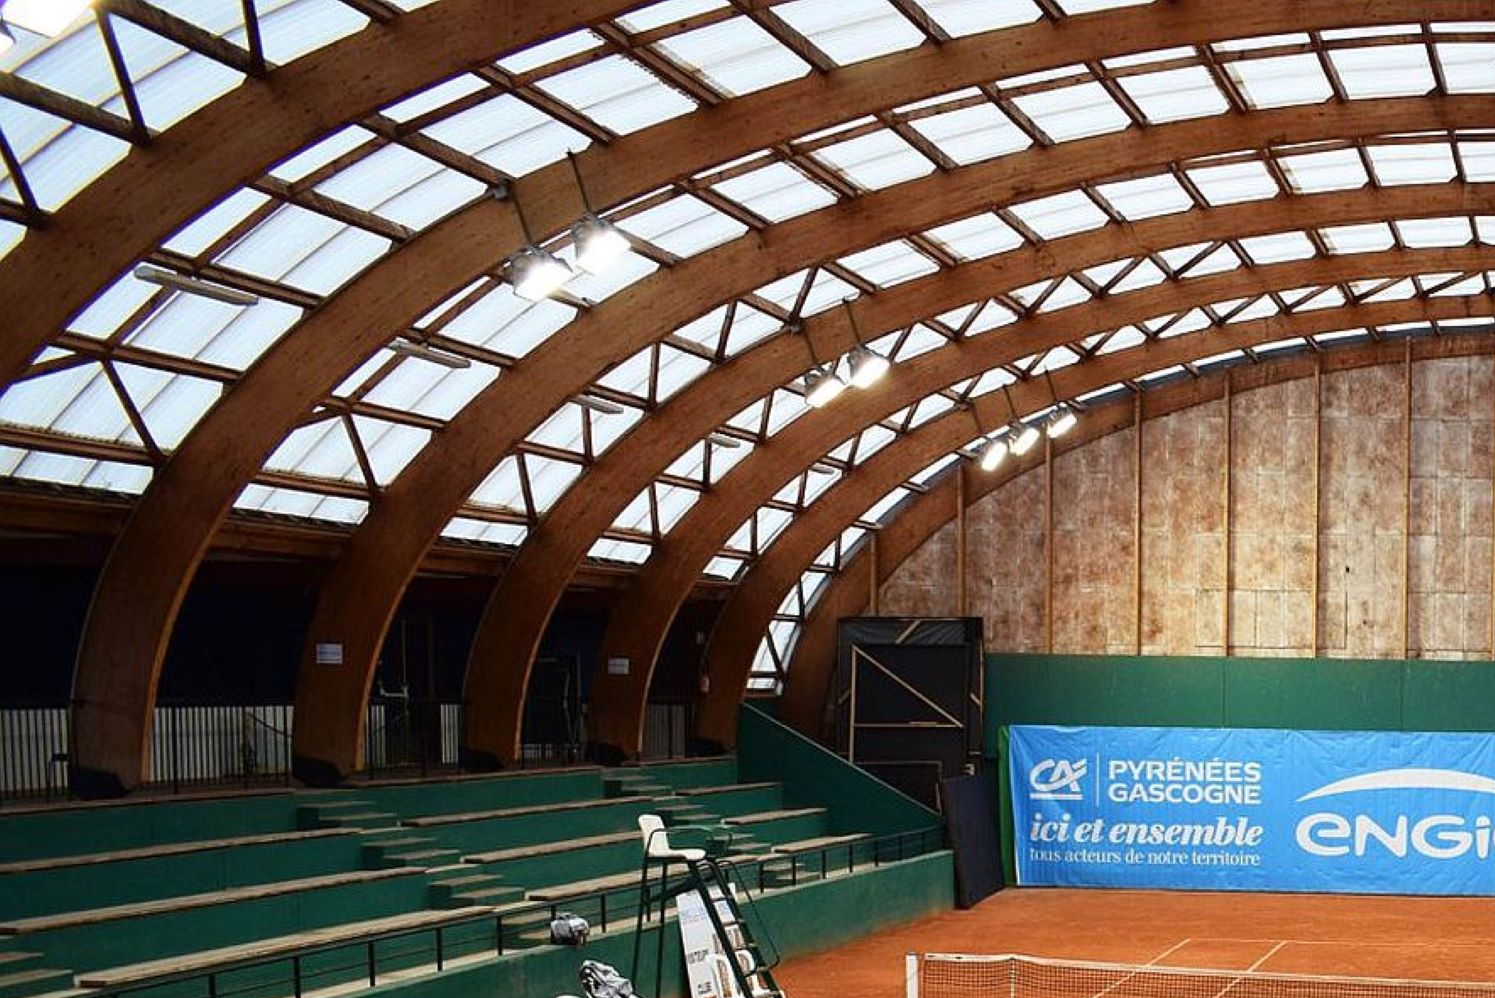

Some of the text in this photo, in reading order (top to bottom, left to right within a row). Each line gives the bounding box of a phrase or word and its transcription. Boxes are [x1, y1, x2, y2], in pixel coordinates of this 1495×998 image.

[1108, 756, 1262, 783] PYRÉNÉES
[1108, 783, 1262, 805] GASCOGNE
[1030, 812, 1264, 846] ici et ensemble
[1030, 847, 1261, 866] tous acteurs de notre territoire
